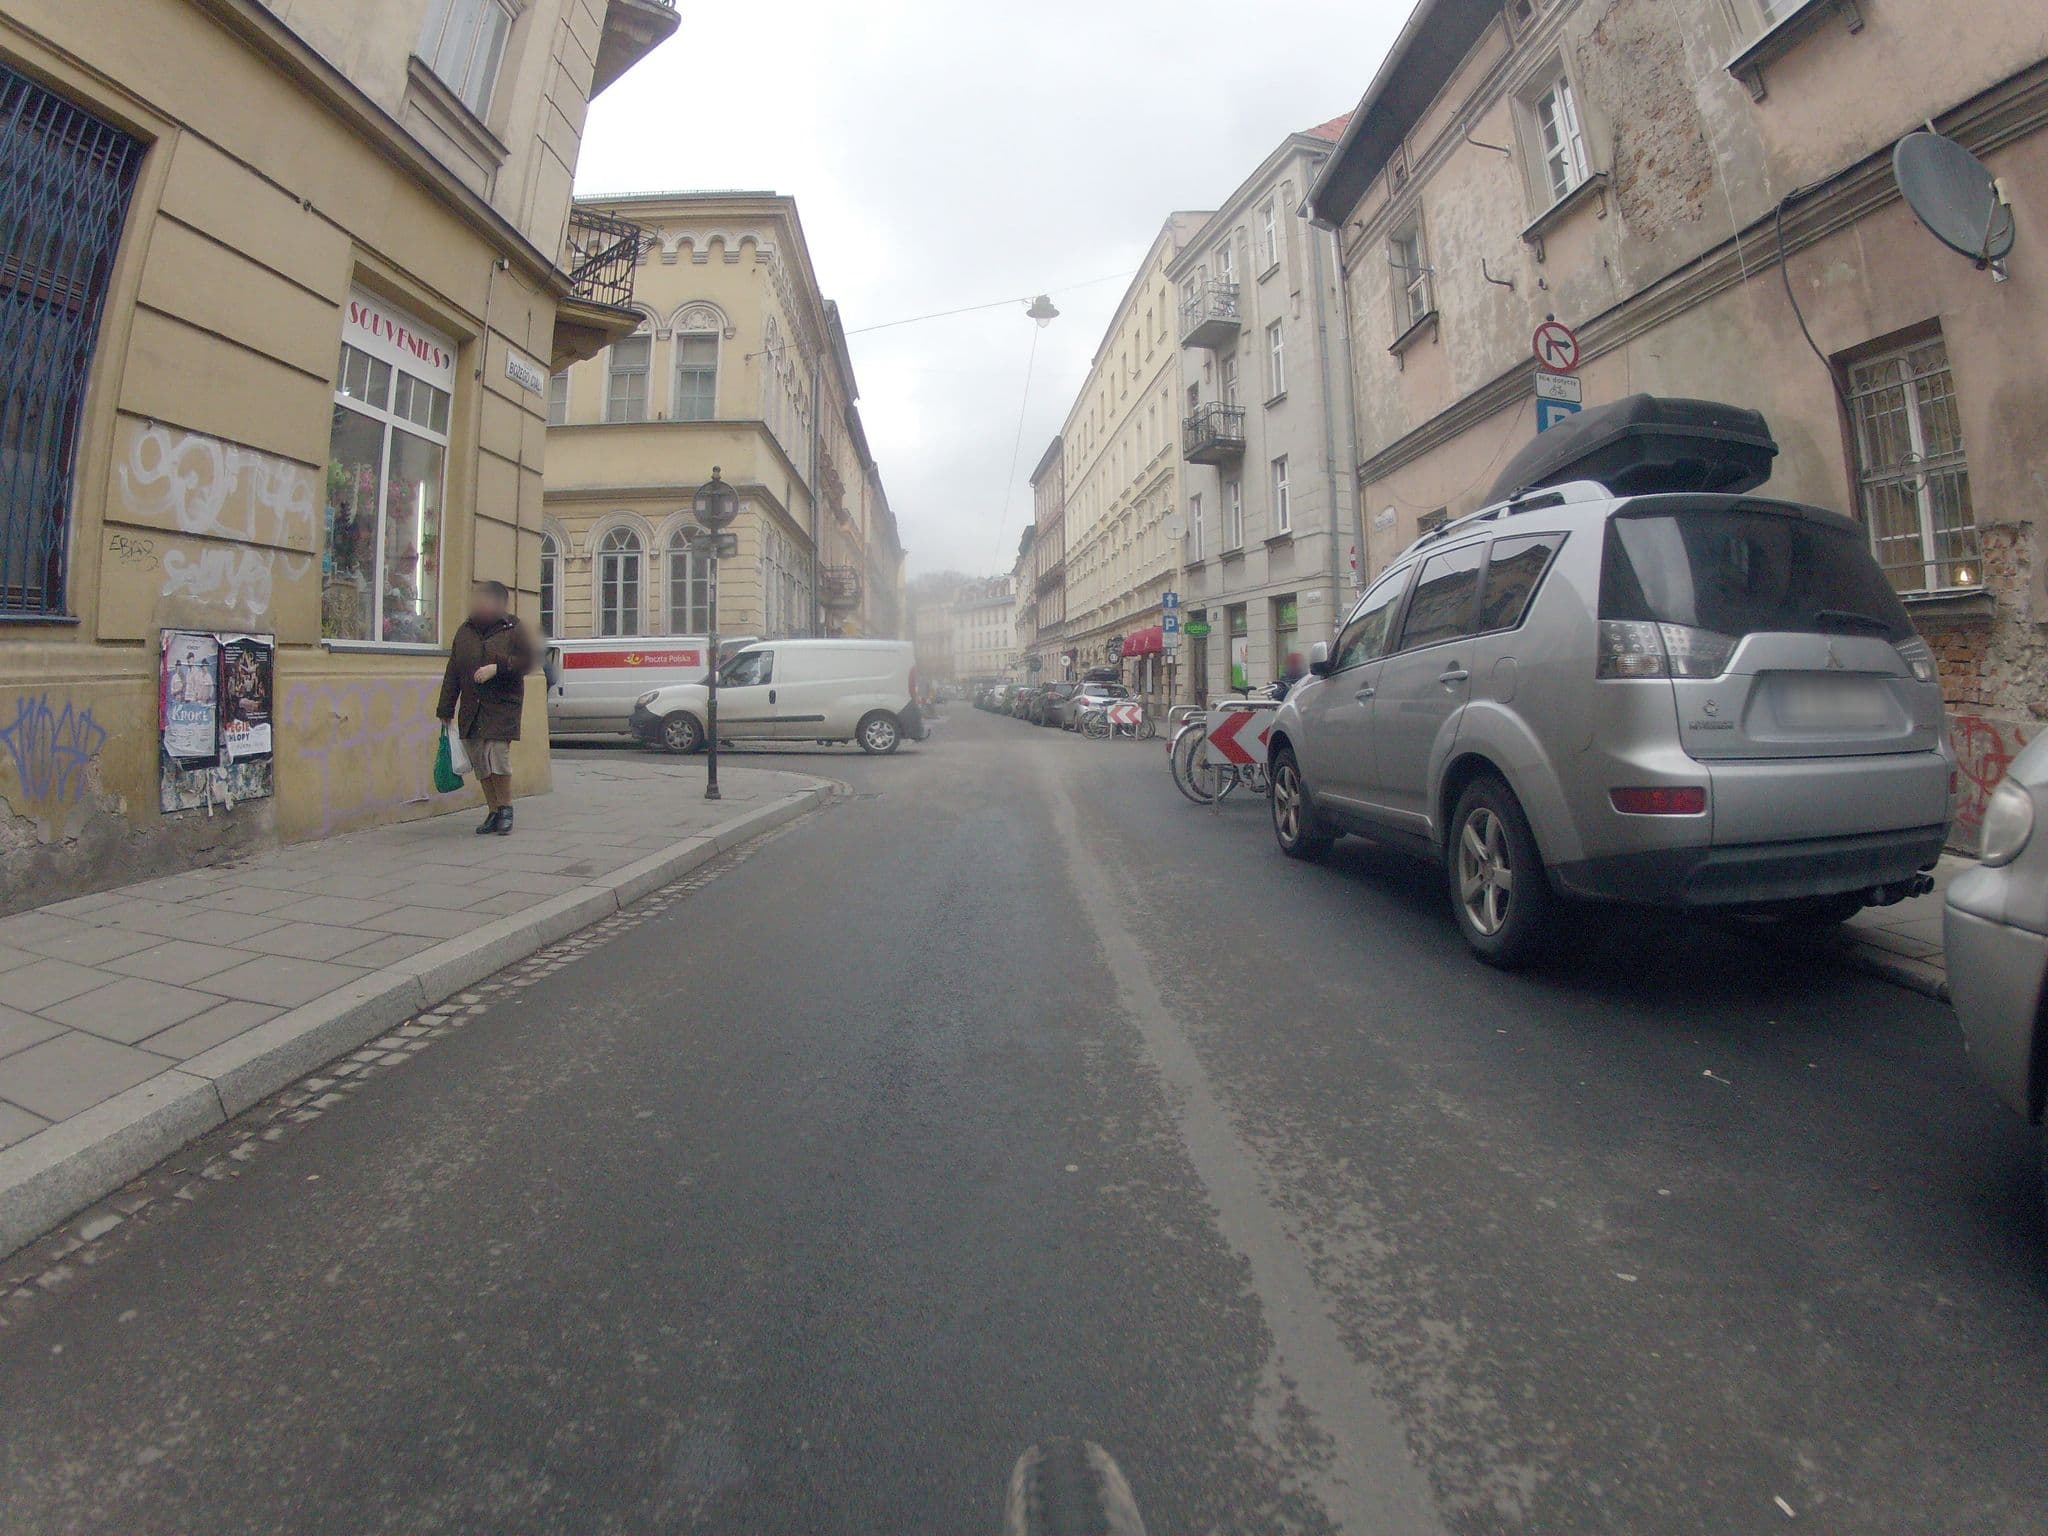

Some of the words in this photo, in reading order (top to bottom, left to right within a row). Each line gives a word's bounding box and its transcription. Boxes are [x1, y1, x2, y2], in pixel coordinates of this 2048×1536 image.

[350, 301, 441, 368] SOUVENIRS
[1165, 618, 1175, 630] P
[645, 655, 668, 663] Poczta
